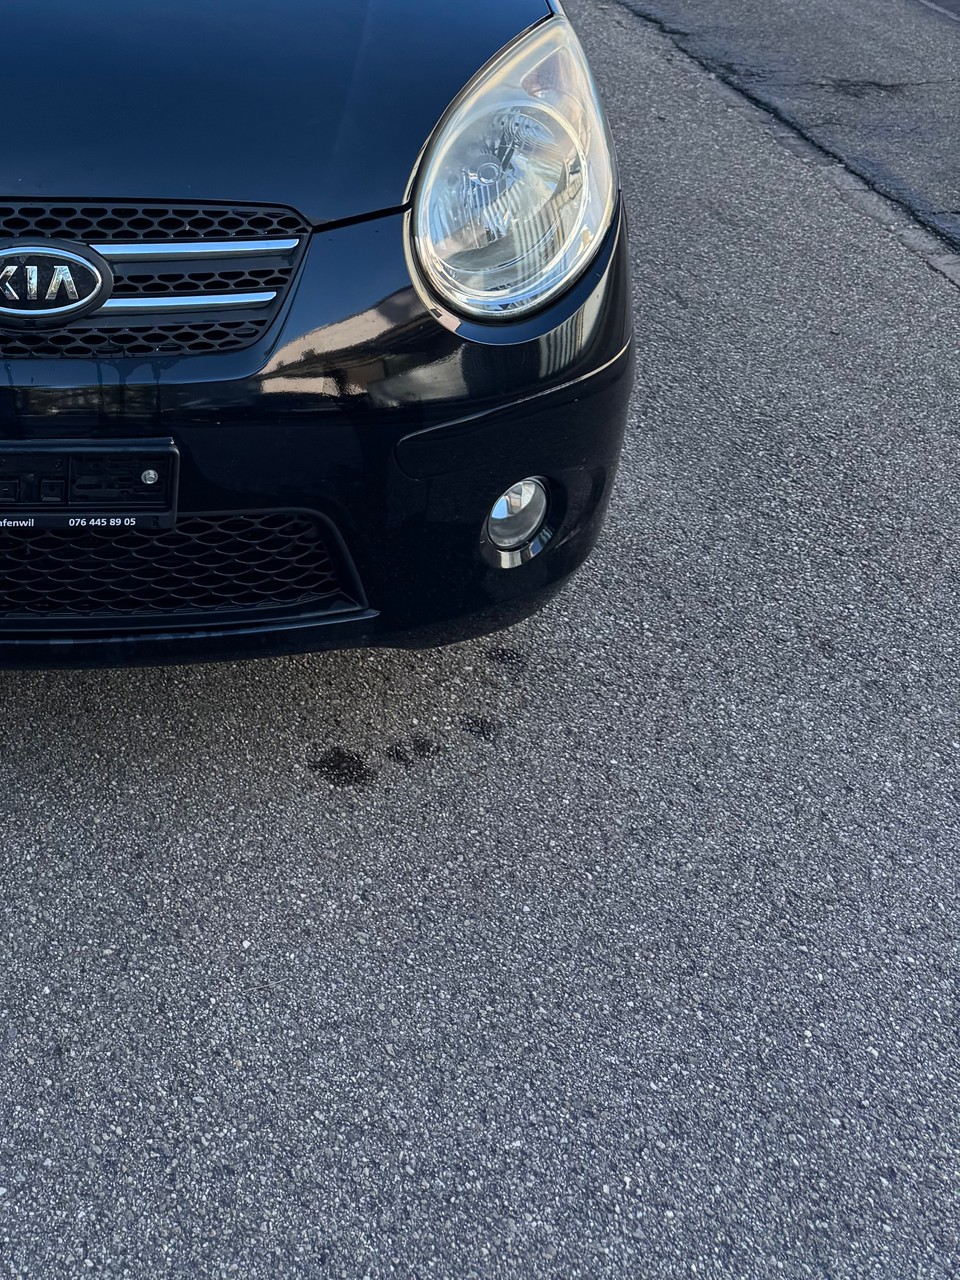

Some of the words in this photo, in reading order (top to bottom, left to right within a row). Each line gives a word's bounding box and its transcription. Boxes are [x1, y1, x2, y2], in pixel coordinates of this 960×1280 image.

[68, 518, 87, 527] 076
[88, 518, 107, 526] 445
[109, 517, 122, 526] 89
[123, 517, 136, 526] 05
